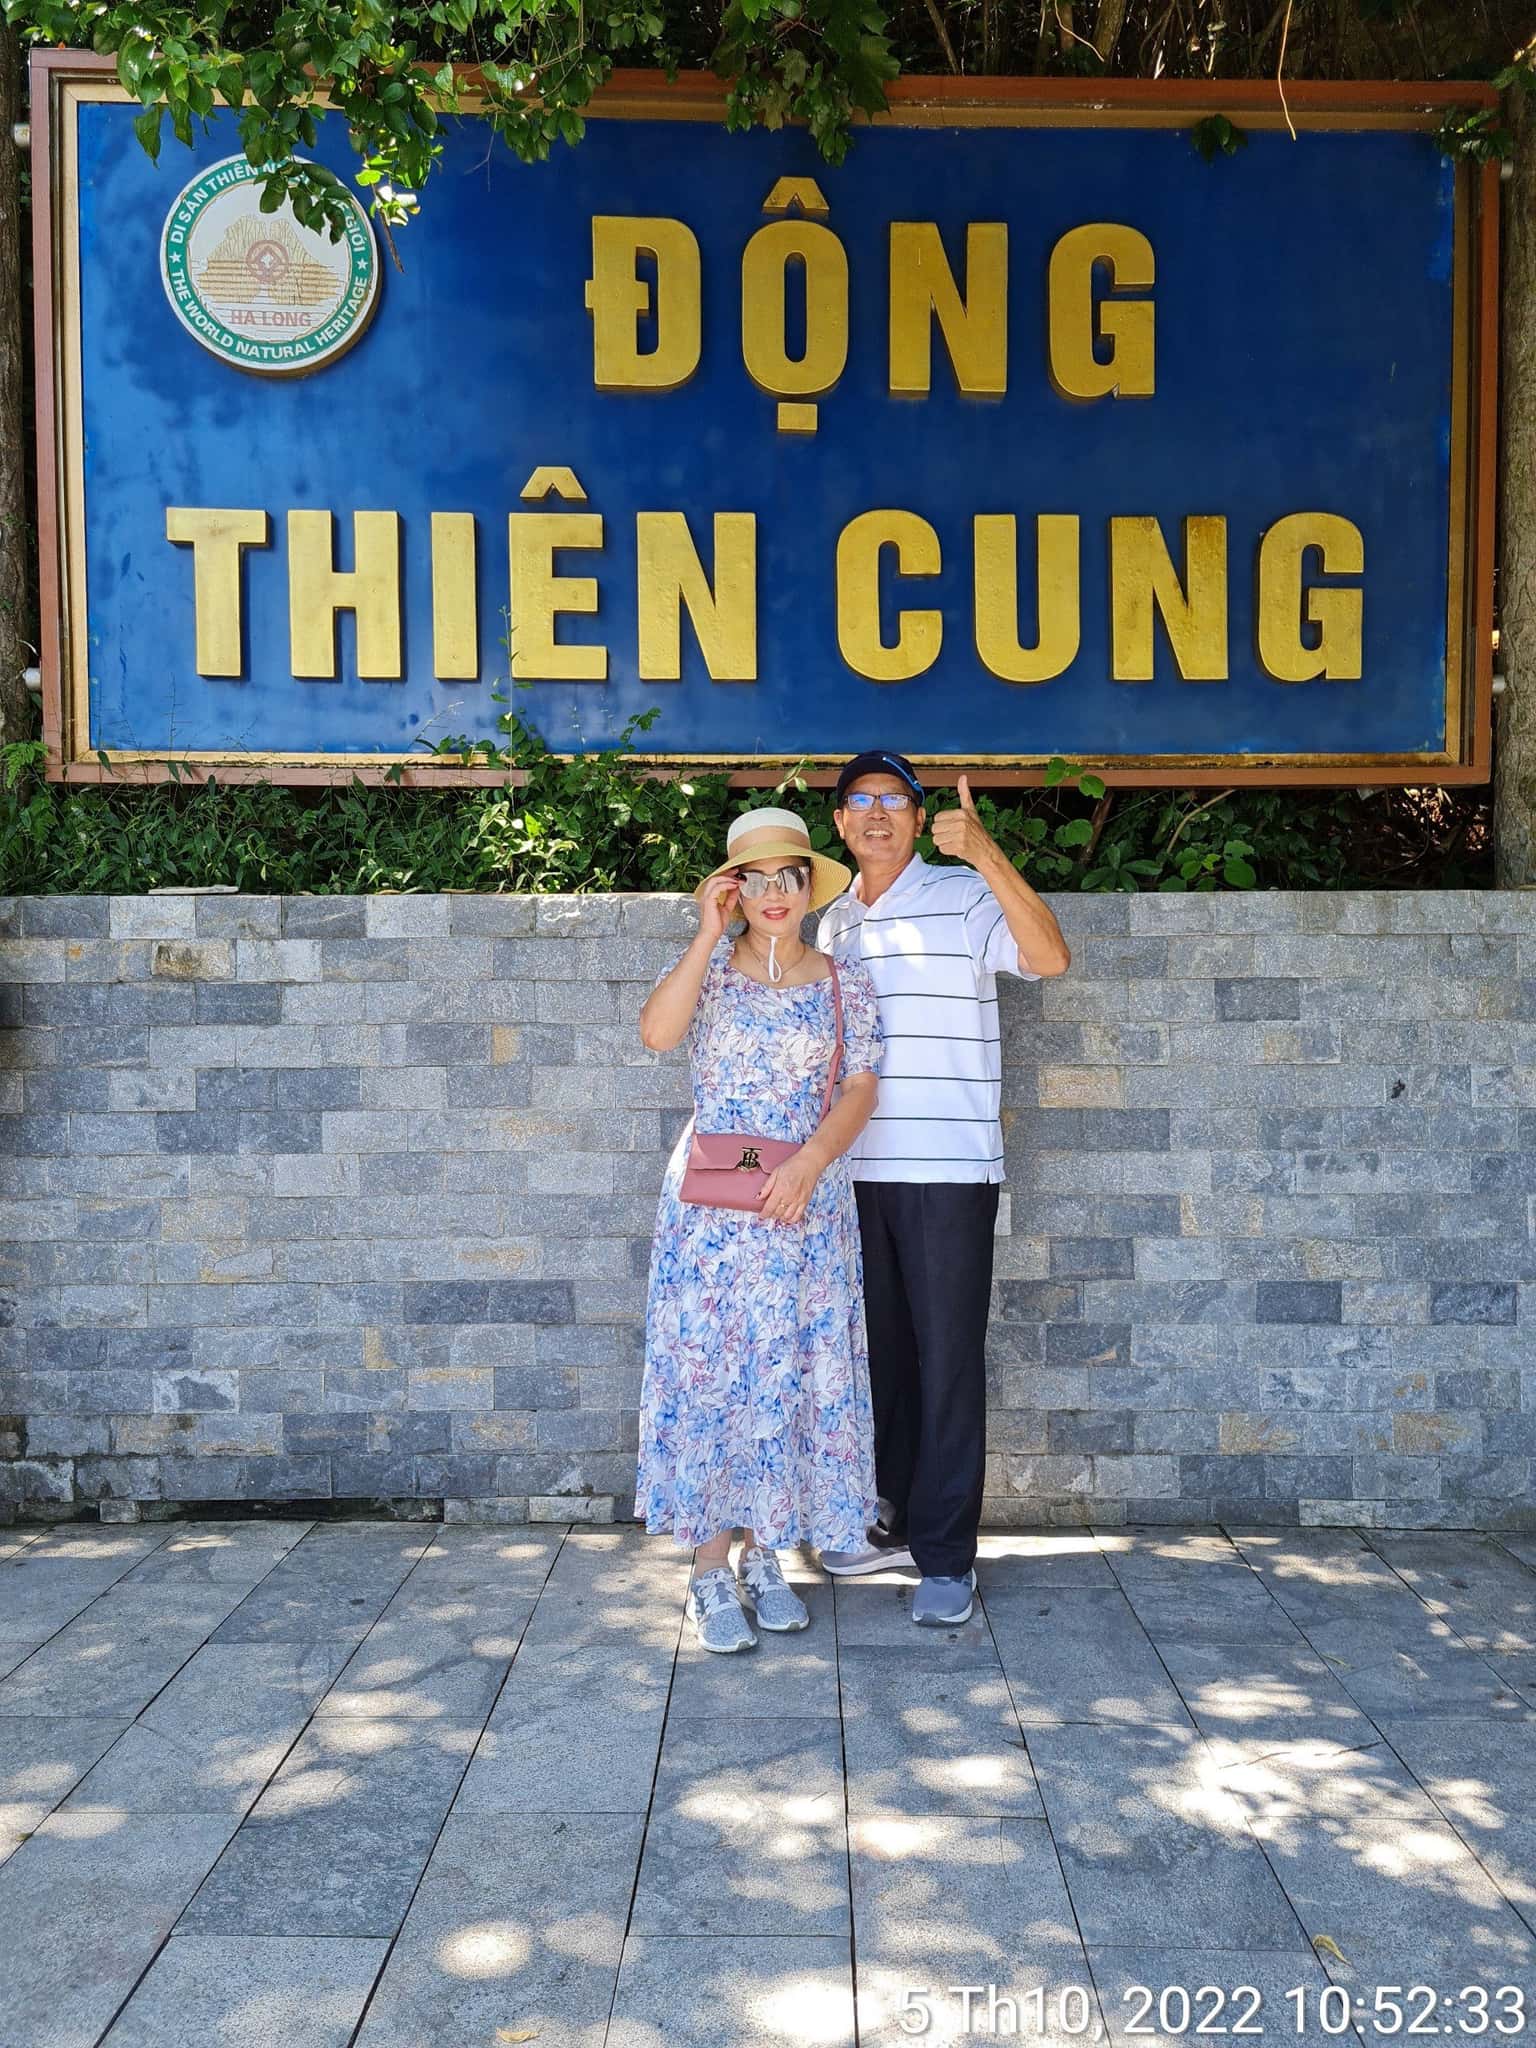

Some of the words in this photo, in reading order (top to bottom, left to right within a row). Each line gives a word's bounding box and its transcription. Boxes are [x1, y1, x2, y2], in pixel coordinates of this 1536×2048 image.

[170, 223, 187, 244] DI
[205, 162, 259, 191] THIÊN
[171, 270, 189, 300] THE
[184, 300, 235, 348] WORLD
[236, 340, 316, 359] NATURAL
[315, 276, 368, 347] HERITAGE
[262, 311, 312, 326] LONG
[585, 176, 1156, 432] ĐỘNG
[166, 466, 759, 681] THIÊN
[836, 509, 1365, 682] CUNG
